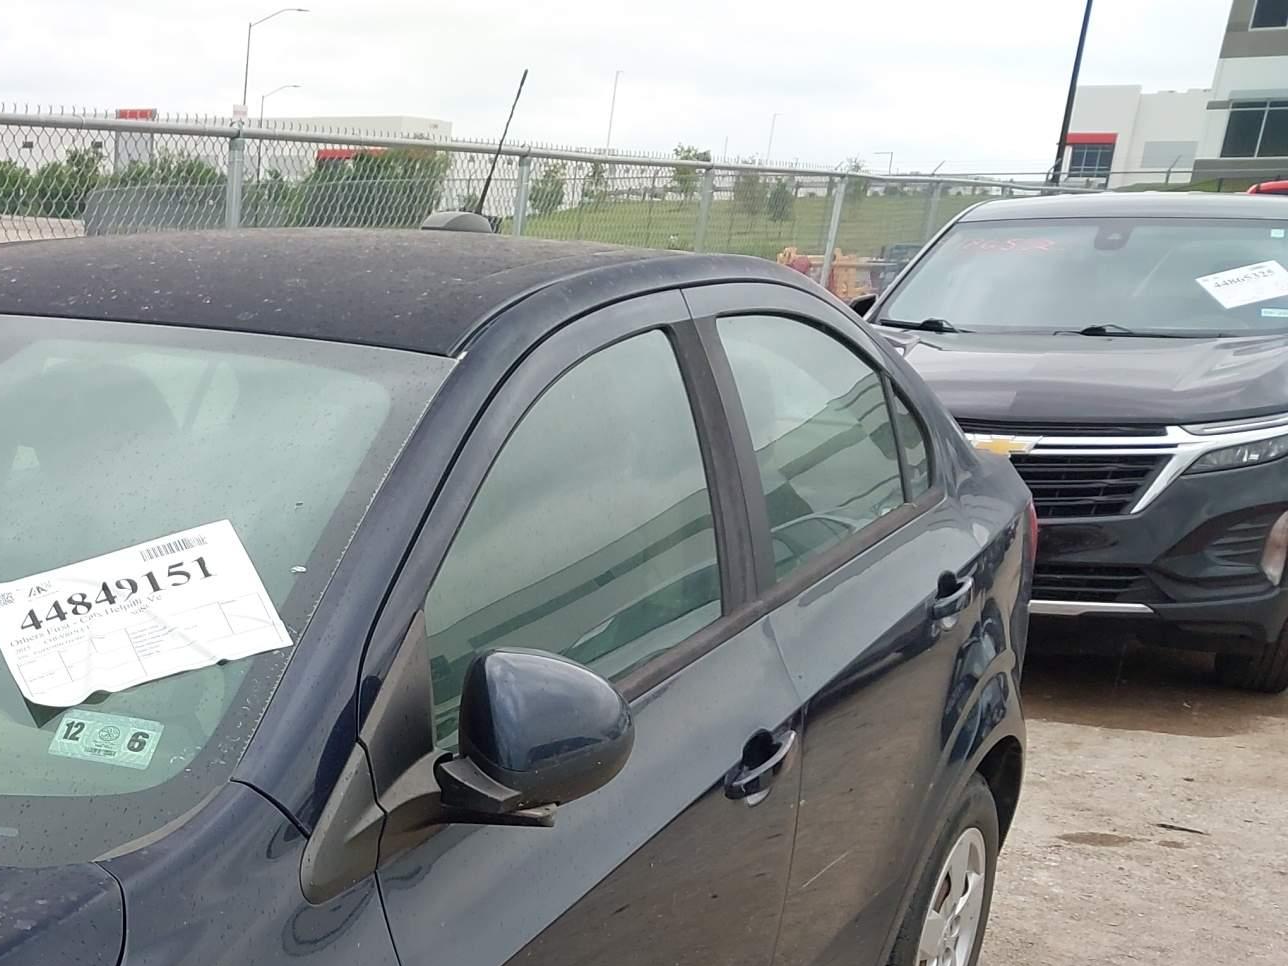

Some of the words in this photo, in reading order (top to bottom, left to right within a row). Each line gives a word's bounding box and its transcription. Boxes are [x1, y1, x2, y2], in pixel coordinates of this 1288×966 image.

[20, 556, 217, 630] 44849151
[62, 720, 85, 741] 12
[127, 731, 150, 752] 6
